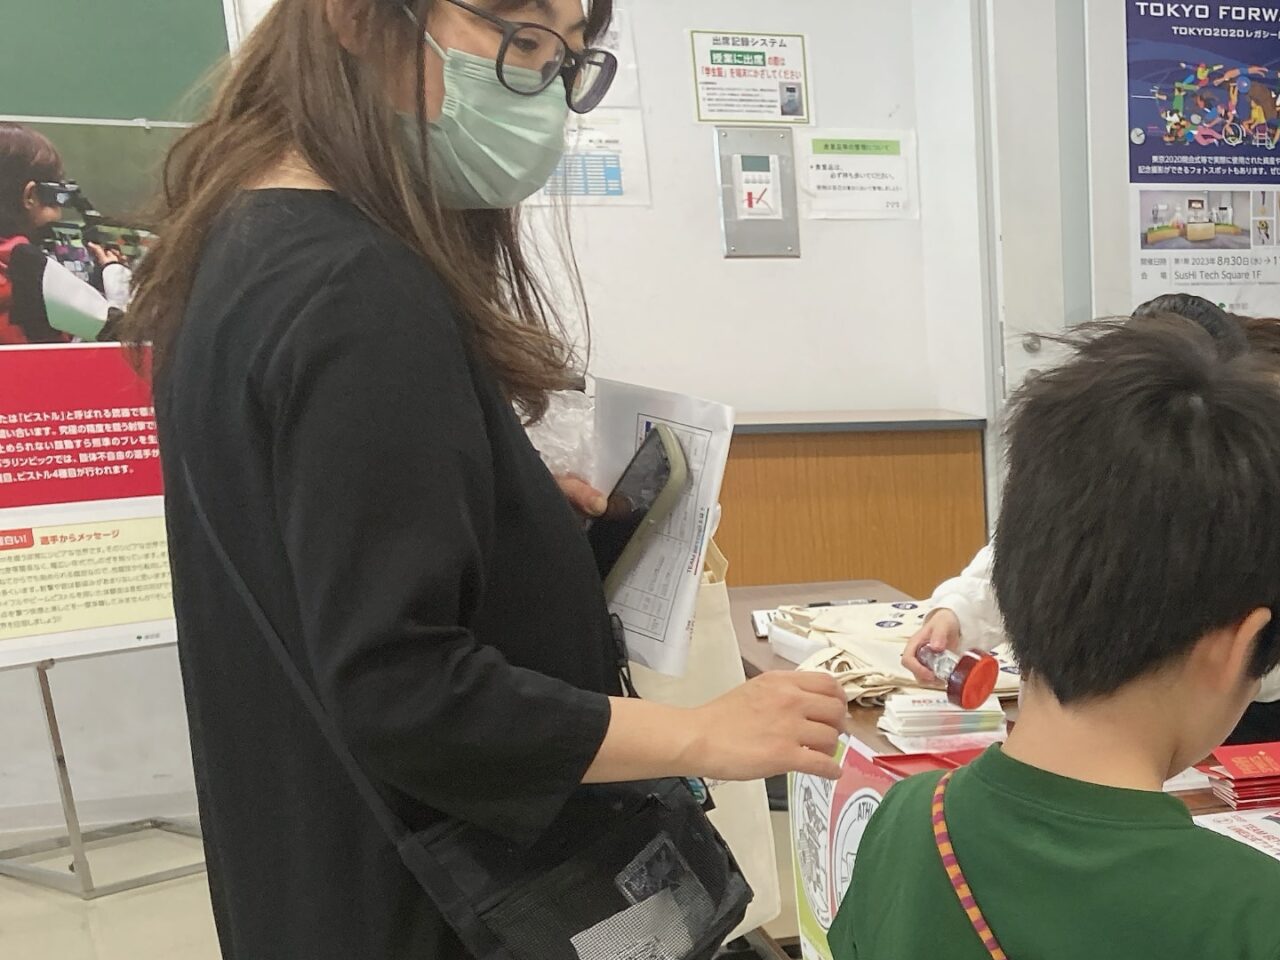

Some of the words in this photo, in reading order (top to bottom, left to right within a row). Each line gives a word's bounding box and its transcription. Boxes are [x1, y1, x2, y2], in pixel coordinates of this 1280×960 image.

[1135, 2, 1209, 19] TOKYO
[1199, 271, 1220, 280] Tech
[1221, 271, 1250, 283] Square
[1252, 271, 1262, 280] 1F
